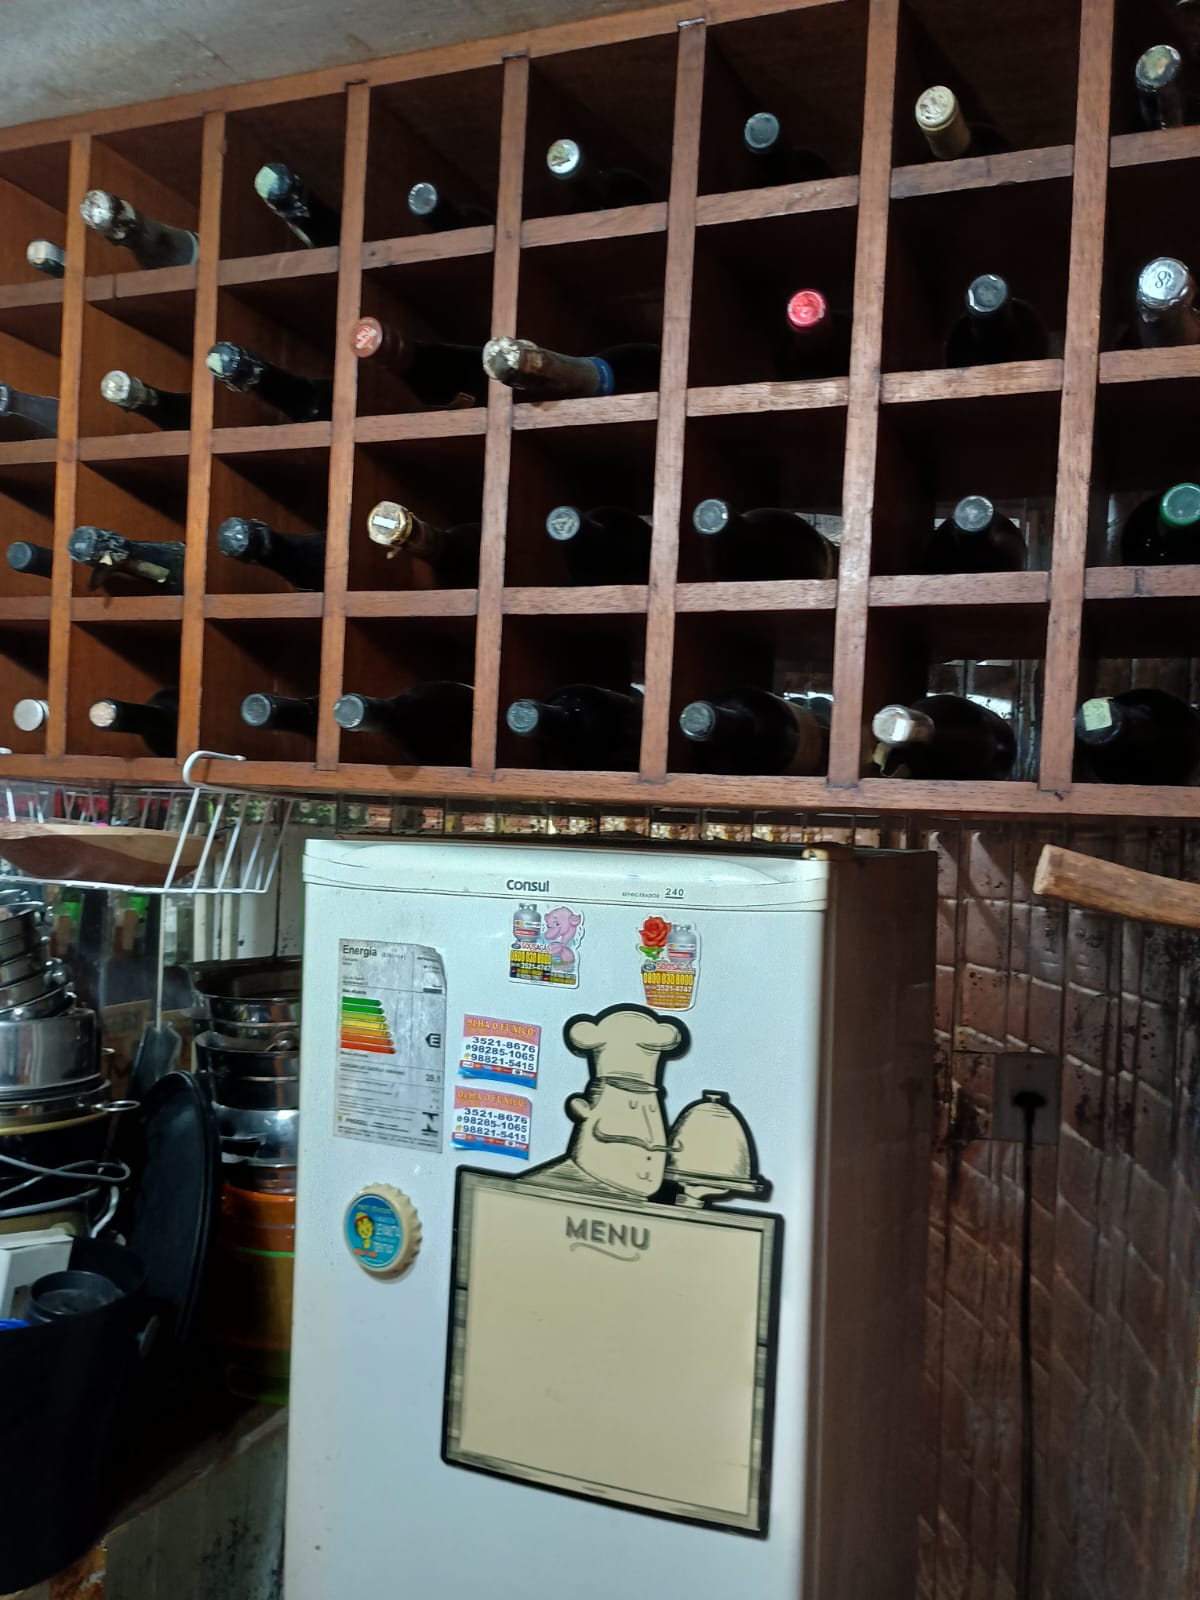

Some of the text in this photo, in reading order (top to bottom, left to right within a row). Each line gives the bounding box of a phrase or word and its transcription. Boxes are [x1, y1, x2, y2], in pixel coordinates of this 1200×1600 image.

[665, 888, 685, 897] 240
[342, 944, 378, 958] Energia
[643, 972, 661, 984] 0800
[675, 974, 693, 986] 8000
[471, 1044, 535, 1061] 98285-1065
[472, 1036, 536, 1053] 3521-8676
[470, 1053, 534, 1071] 98821-5415
[463, 1115, 527, 1133] 98285-1065
[464, 1107, 528, 1124] 3521-8676
[462, 1124, 527, 1142] 98821-5415
[565, 1215, 651, 1251] MENU
